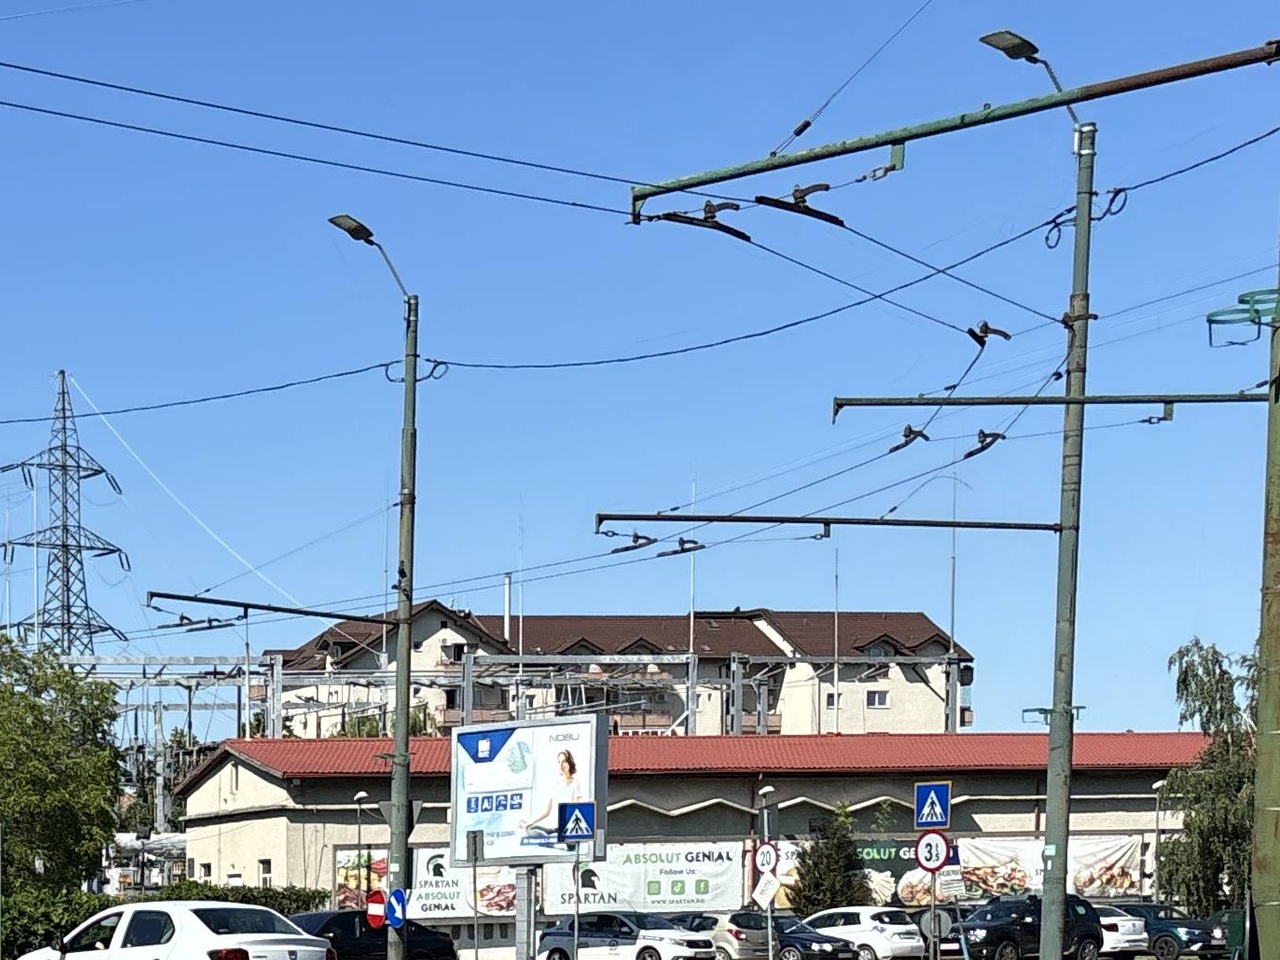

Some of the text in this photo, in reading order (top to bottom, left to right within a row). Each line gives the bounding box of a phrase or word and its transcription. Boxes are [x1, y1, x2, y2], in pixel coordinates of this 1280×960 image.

[622, 851, 733, 865] ABSOLUT GENIAL
[760, 851, 771, 866] 20
[856, 847, 897, 860] SOLUT
[418, 879, 459, 888] SPARTAN
[416, 891, 461, 901] ABSOLUT
[560, 892, 618, 905] SPARTAN
[421, 902, 456, 912] GENIAL
